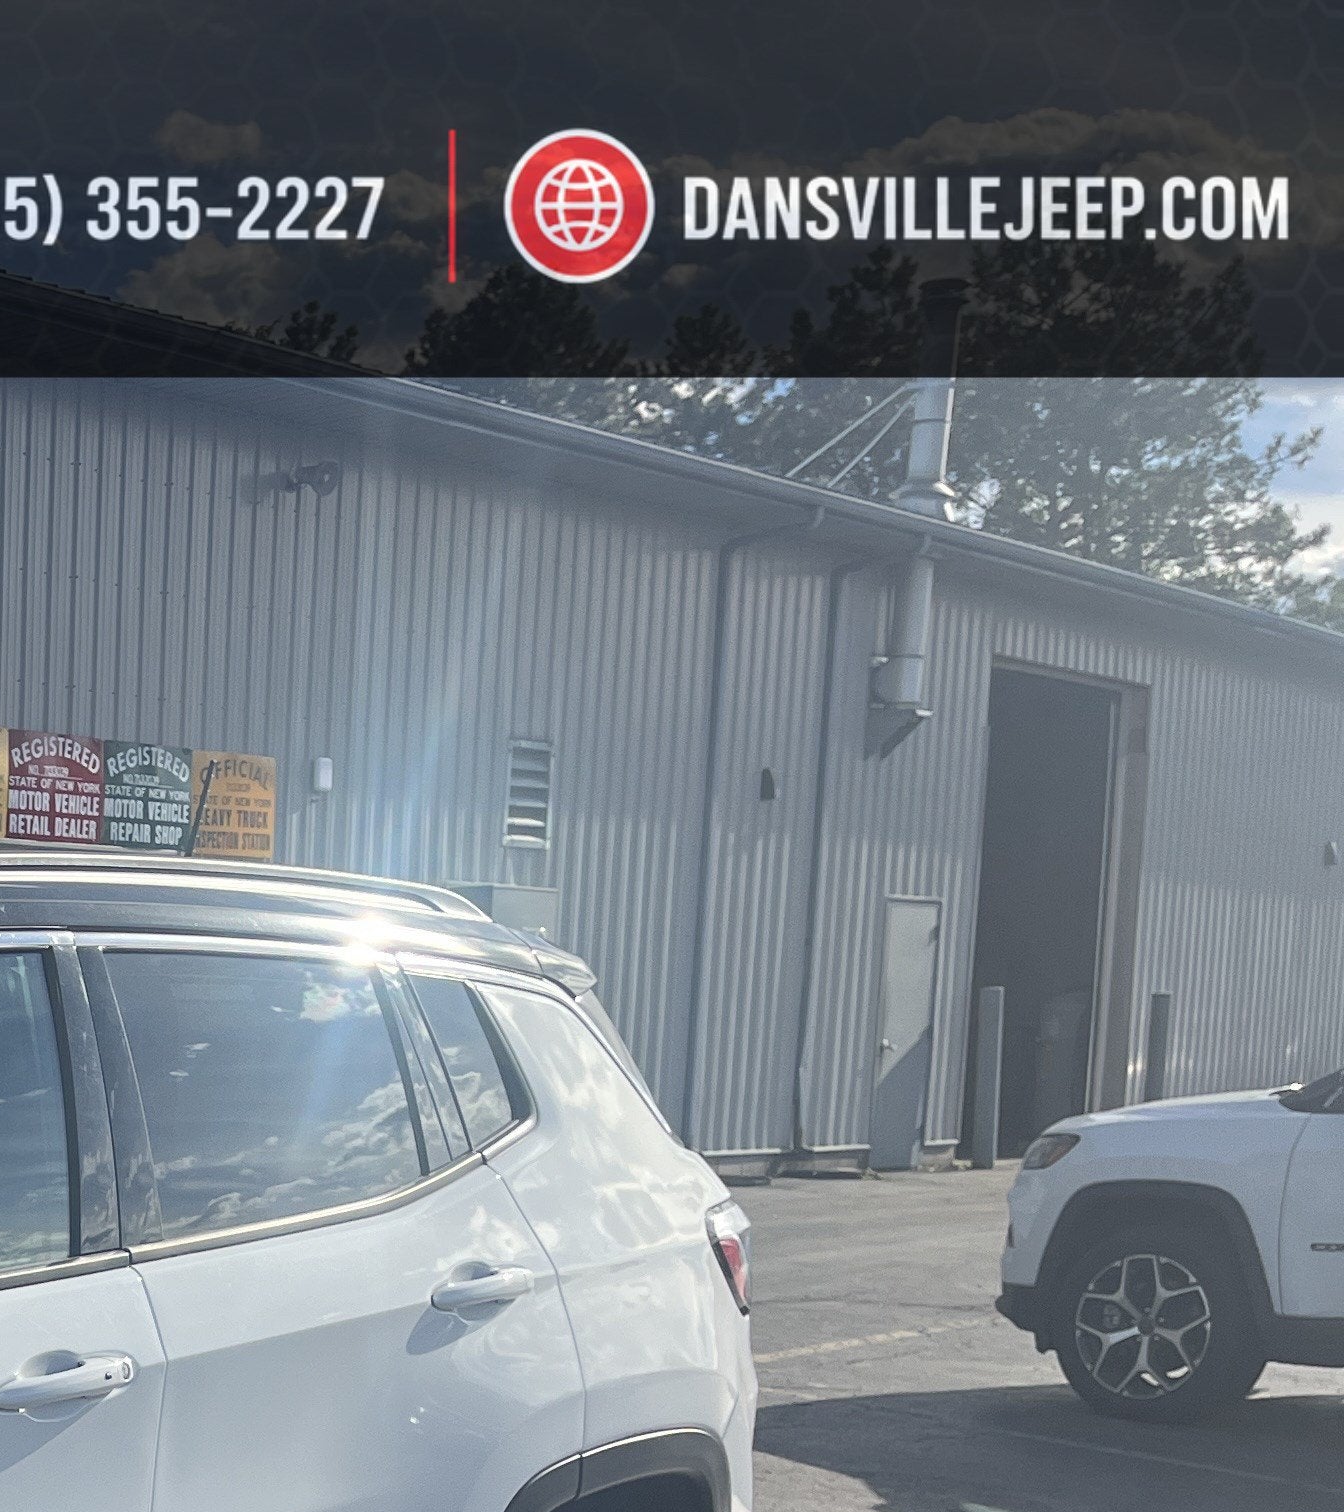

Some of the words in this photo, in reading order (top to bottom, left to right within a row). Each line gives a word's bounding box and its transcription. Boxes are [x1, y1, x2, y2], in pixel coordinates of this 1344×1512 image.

[11, 736, 100, 774] REGISTERED
[106, 746, 190, 782] REGISTERED
[9, 776, 38, 788] STATE
[40, 778, 53, 789] OF
[55, 780, 75, 791] NEW
[77, 782, 100, 794] YORK
[105, 784, 132, 796] STATE
[134, 787, 146, 798] OF
[148, 788, 167, 800] NEW
[169, 790, 190, 802] YORK
[8, 789, 50, 812] MOTOR
[54, 793, 100, 816] VEHICLE
[104, 798, 144, 819] MOTOR
[147, 801, 190, 824] VEHICLE
[9, 814, 51, 836] RETAIL
[54, 817, 97, 840] DEALER
[196, 808, 233, 826] EAVY
[236, 809, 269, 829] TRUCK
[110, 821, 151, 844] REPAIR
[154, 825, 183, 846] SHOP
[242, 833, 271, 851] STATION
